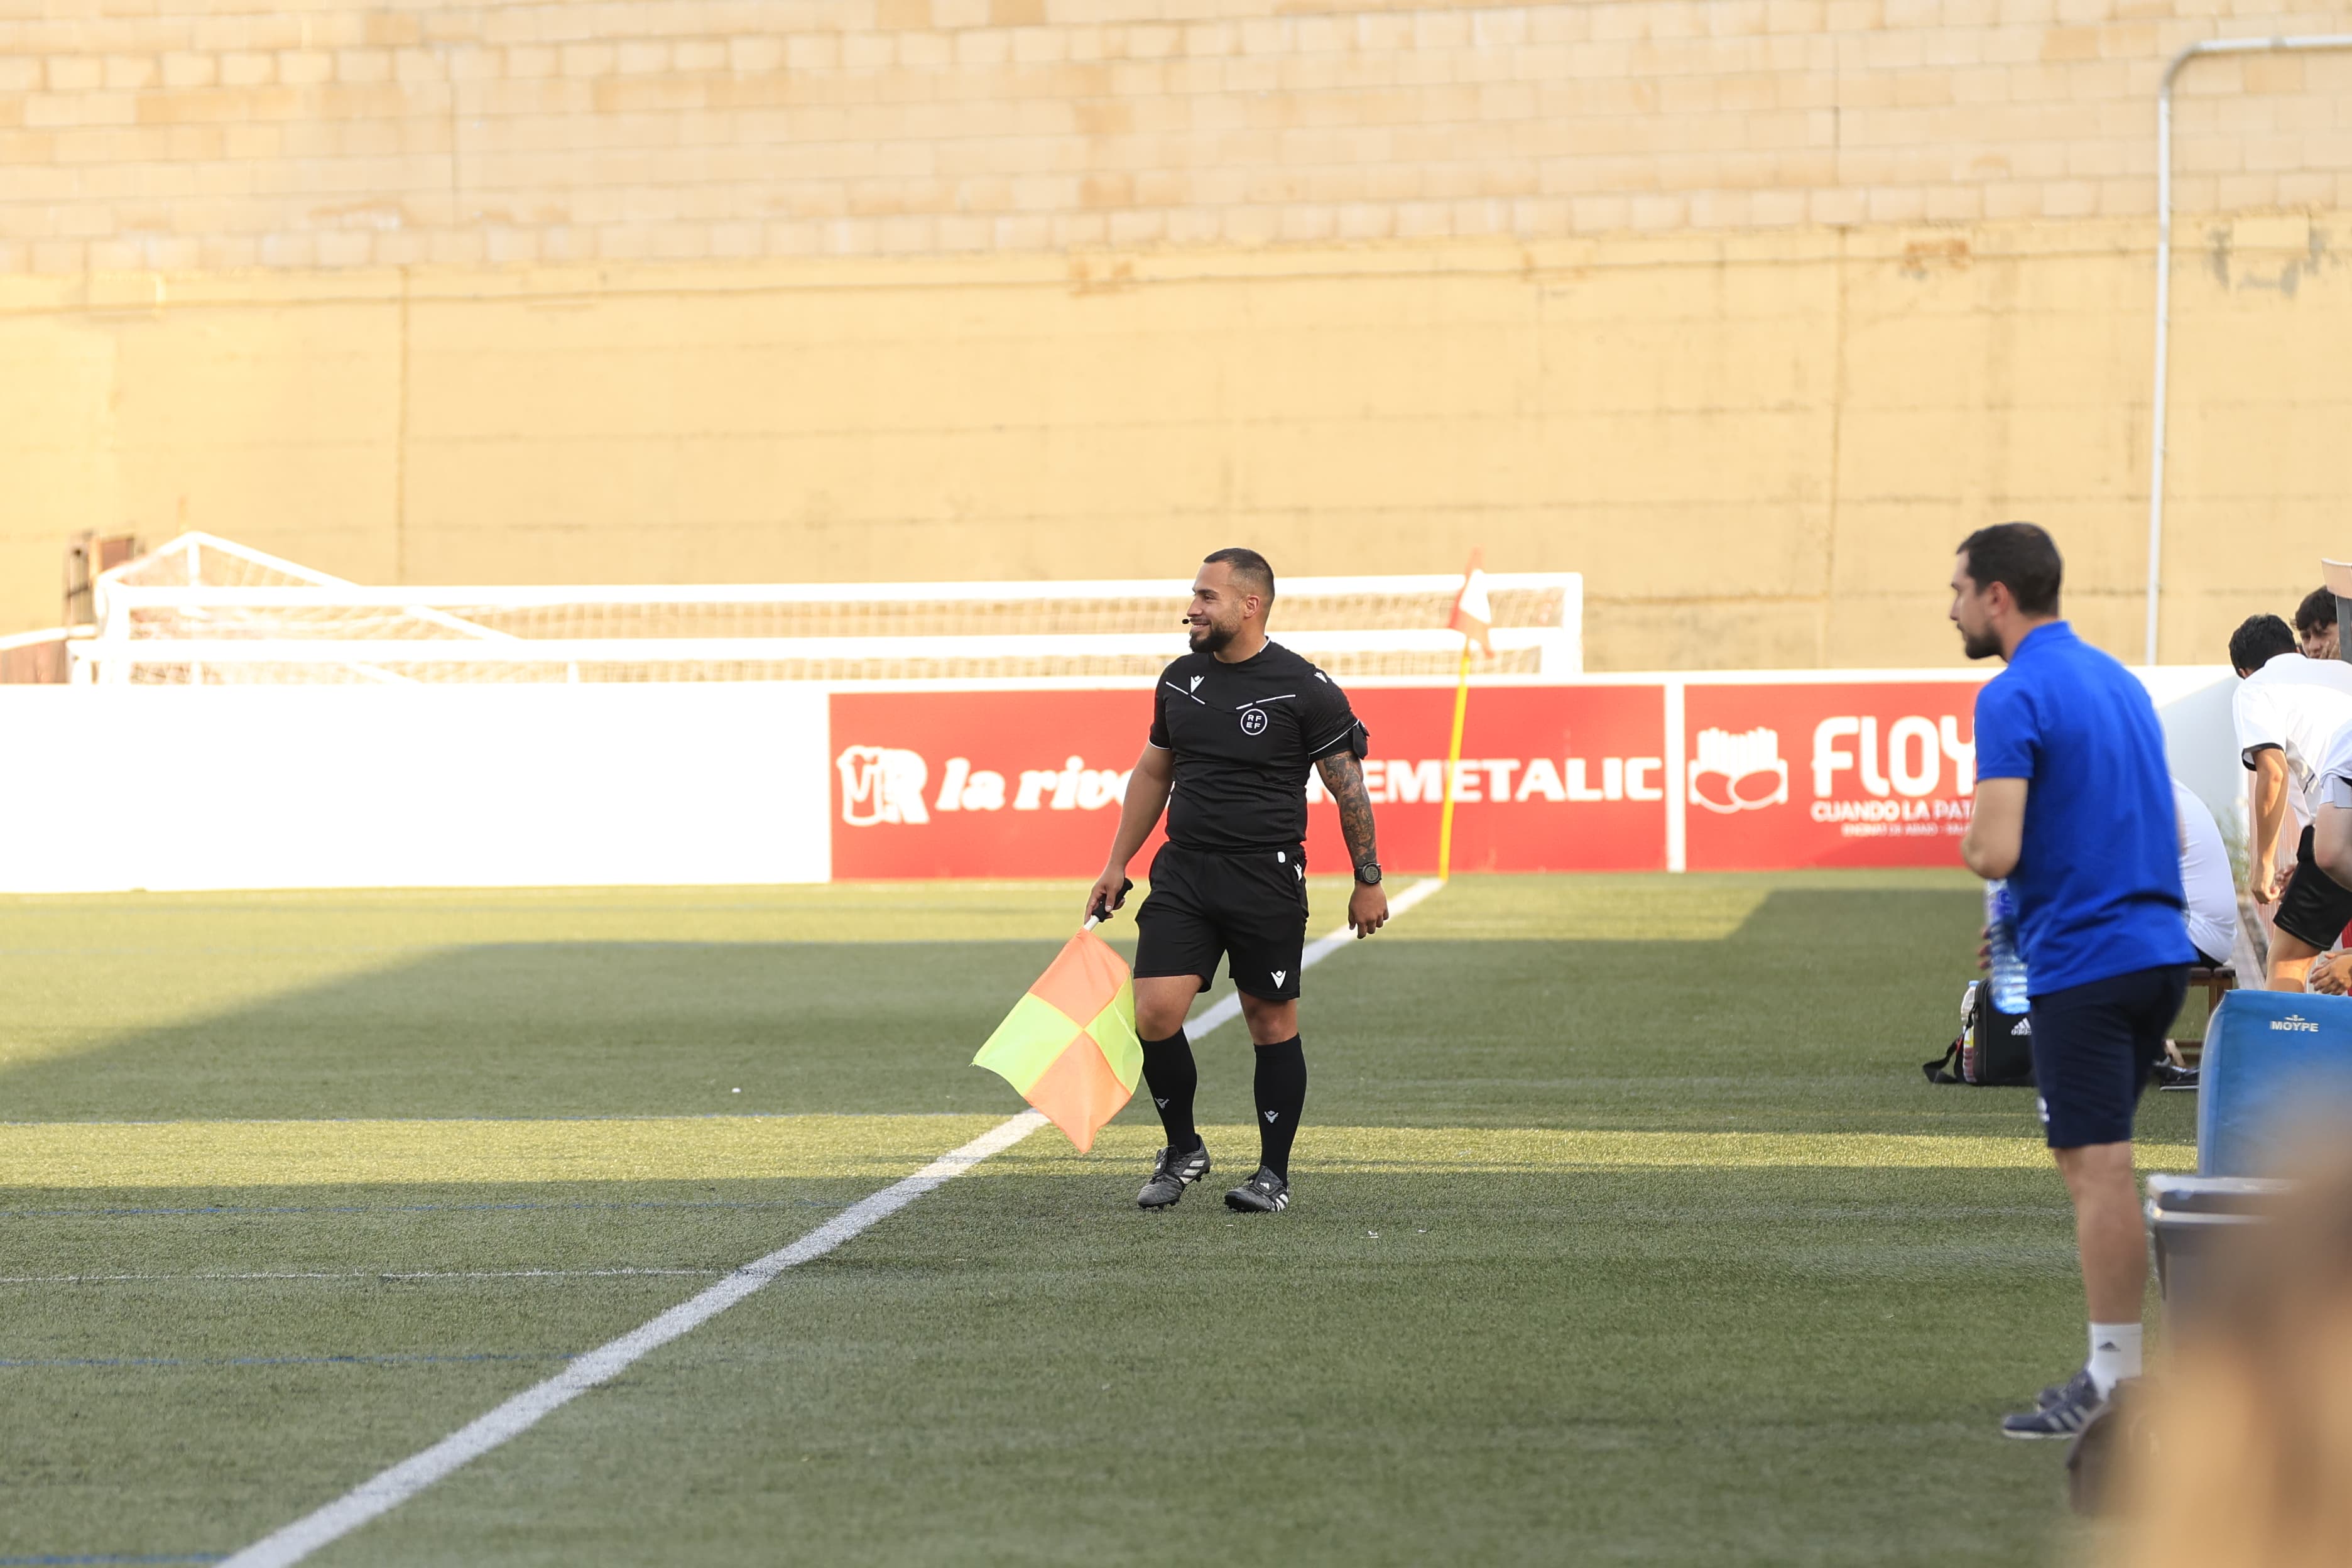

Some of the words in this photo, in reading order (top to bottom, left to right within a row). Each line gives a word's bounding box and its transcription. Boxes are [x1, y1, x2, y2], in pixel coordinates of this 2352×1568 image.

[936, 758, 1005, 810] la
[1810, 800, 1900, 822] CUANDO
[1902, 800, 1930, 821] LA
[2270, 1021, 2319, 1032] MOYPE
